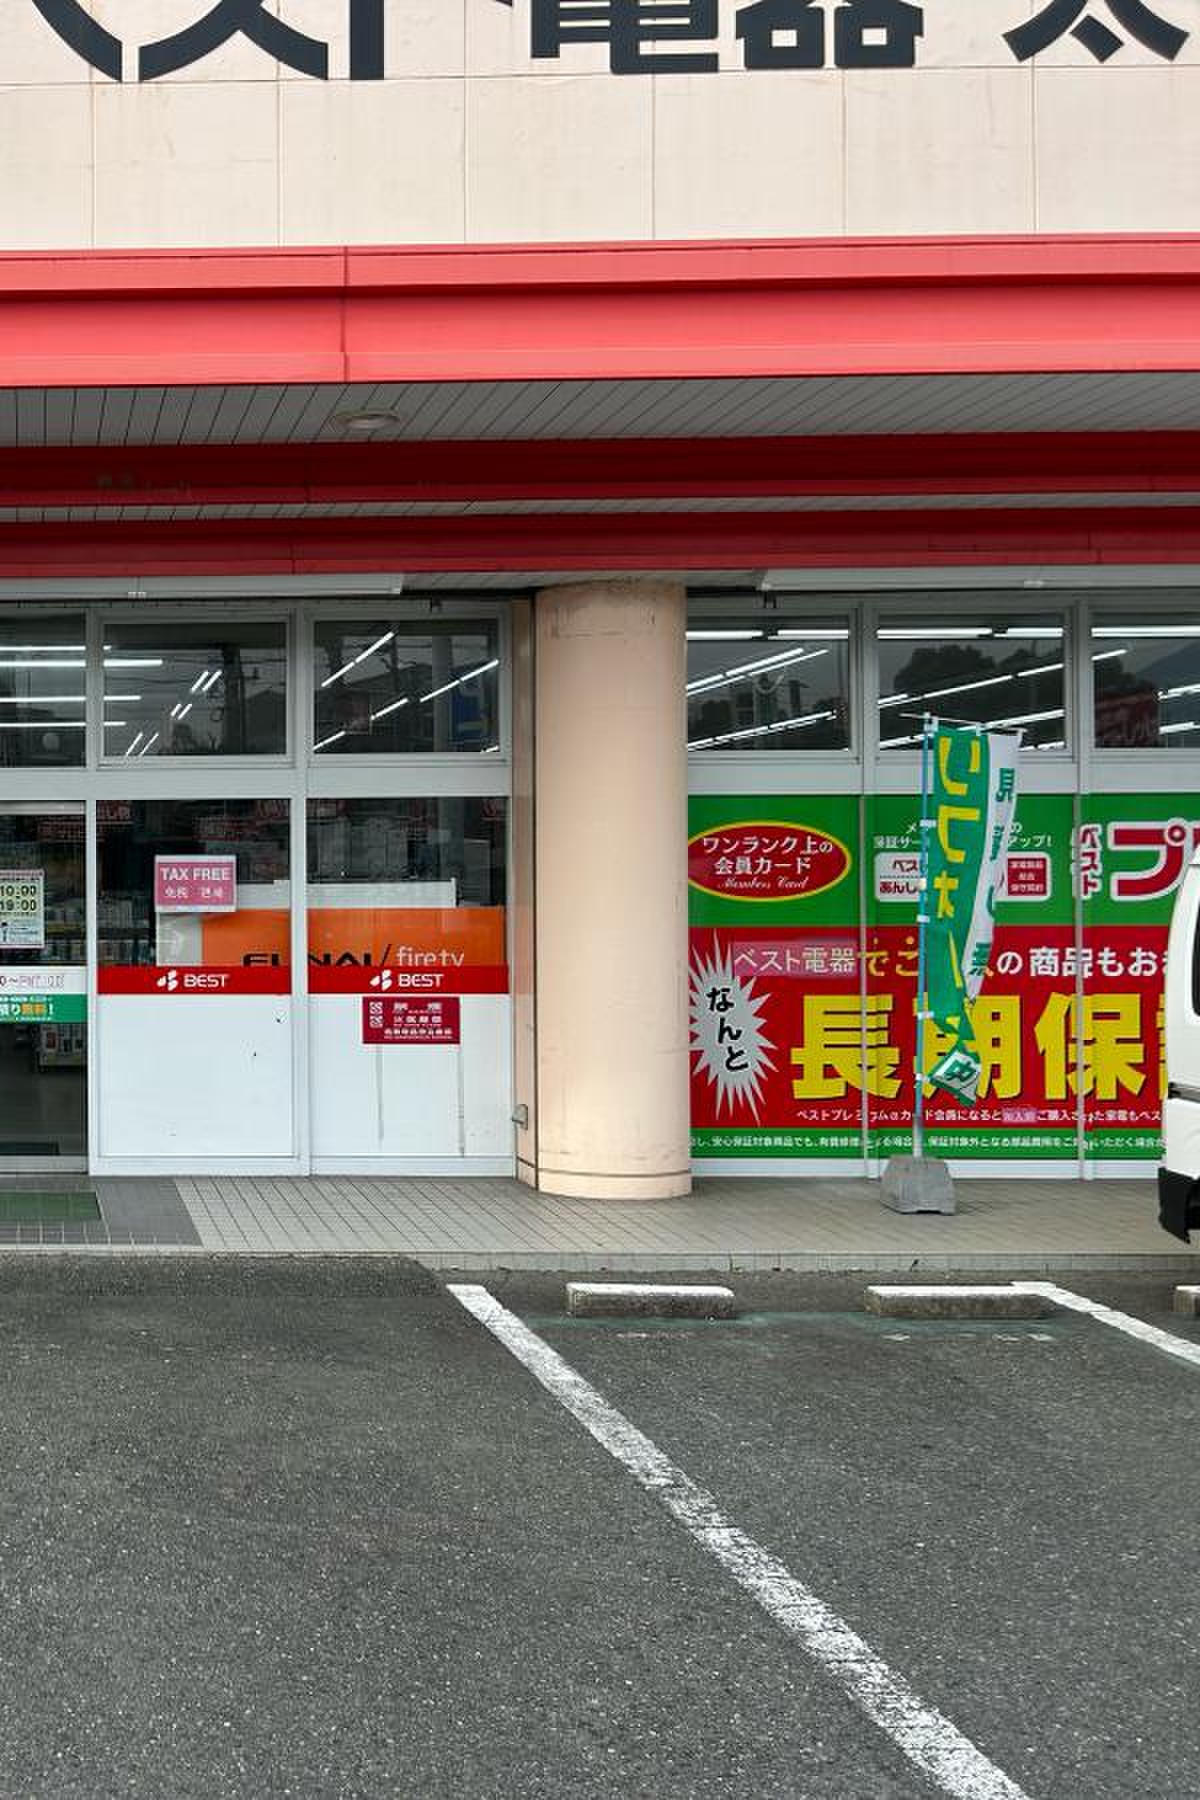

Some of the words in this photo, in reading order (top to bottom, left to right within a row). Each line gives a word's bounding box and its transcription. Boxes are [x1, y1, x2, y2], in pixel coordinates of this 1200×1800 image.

[703, 835, 833, 855] ワンランク上の
[160, 867, 189, 881] TAX
[193, 867, 231, 881] FREE
[714, 856, 812, 876] 会員カード
[183, 973, 230, 988] BEST
[398, 973, 446, 988] BEST
[706, 986, 750, 1071] なんと
